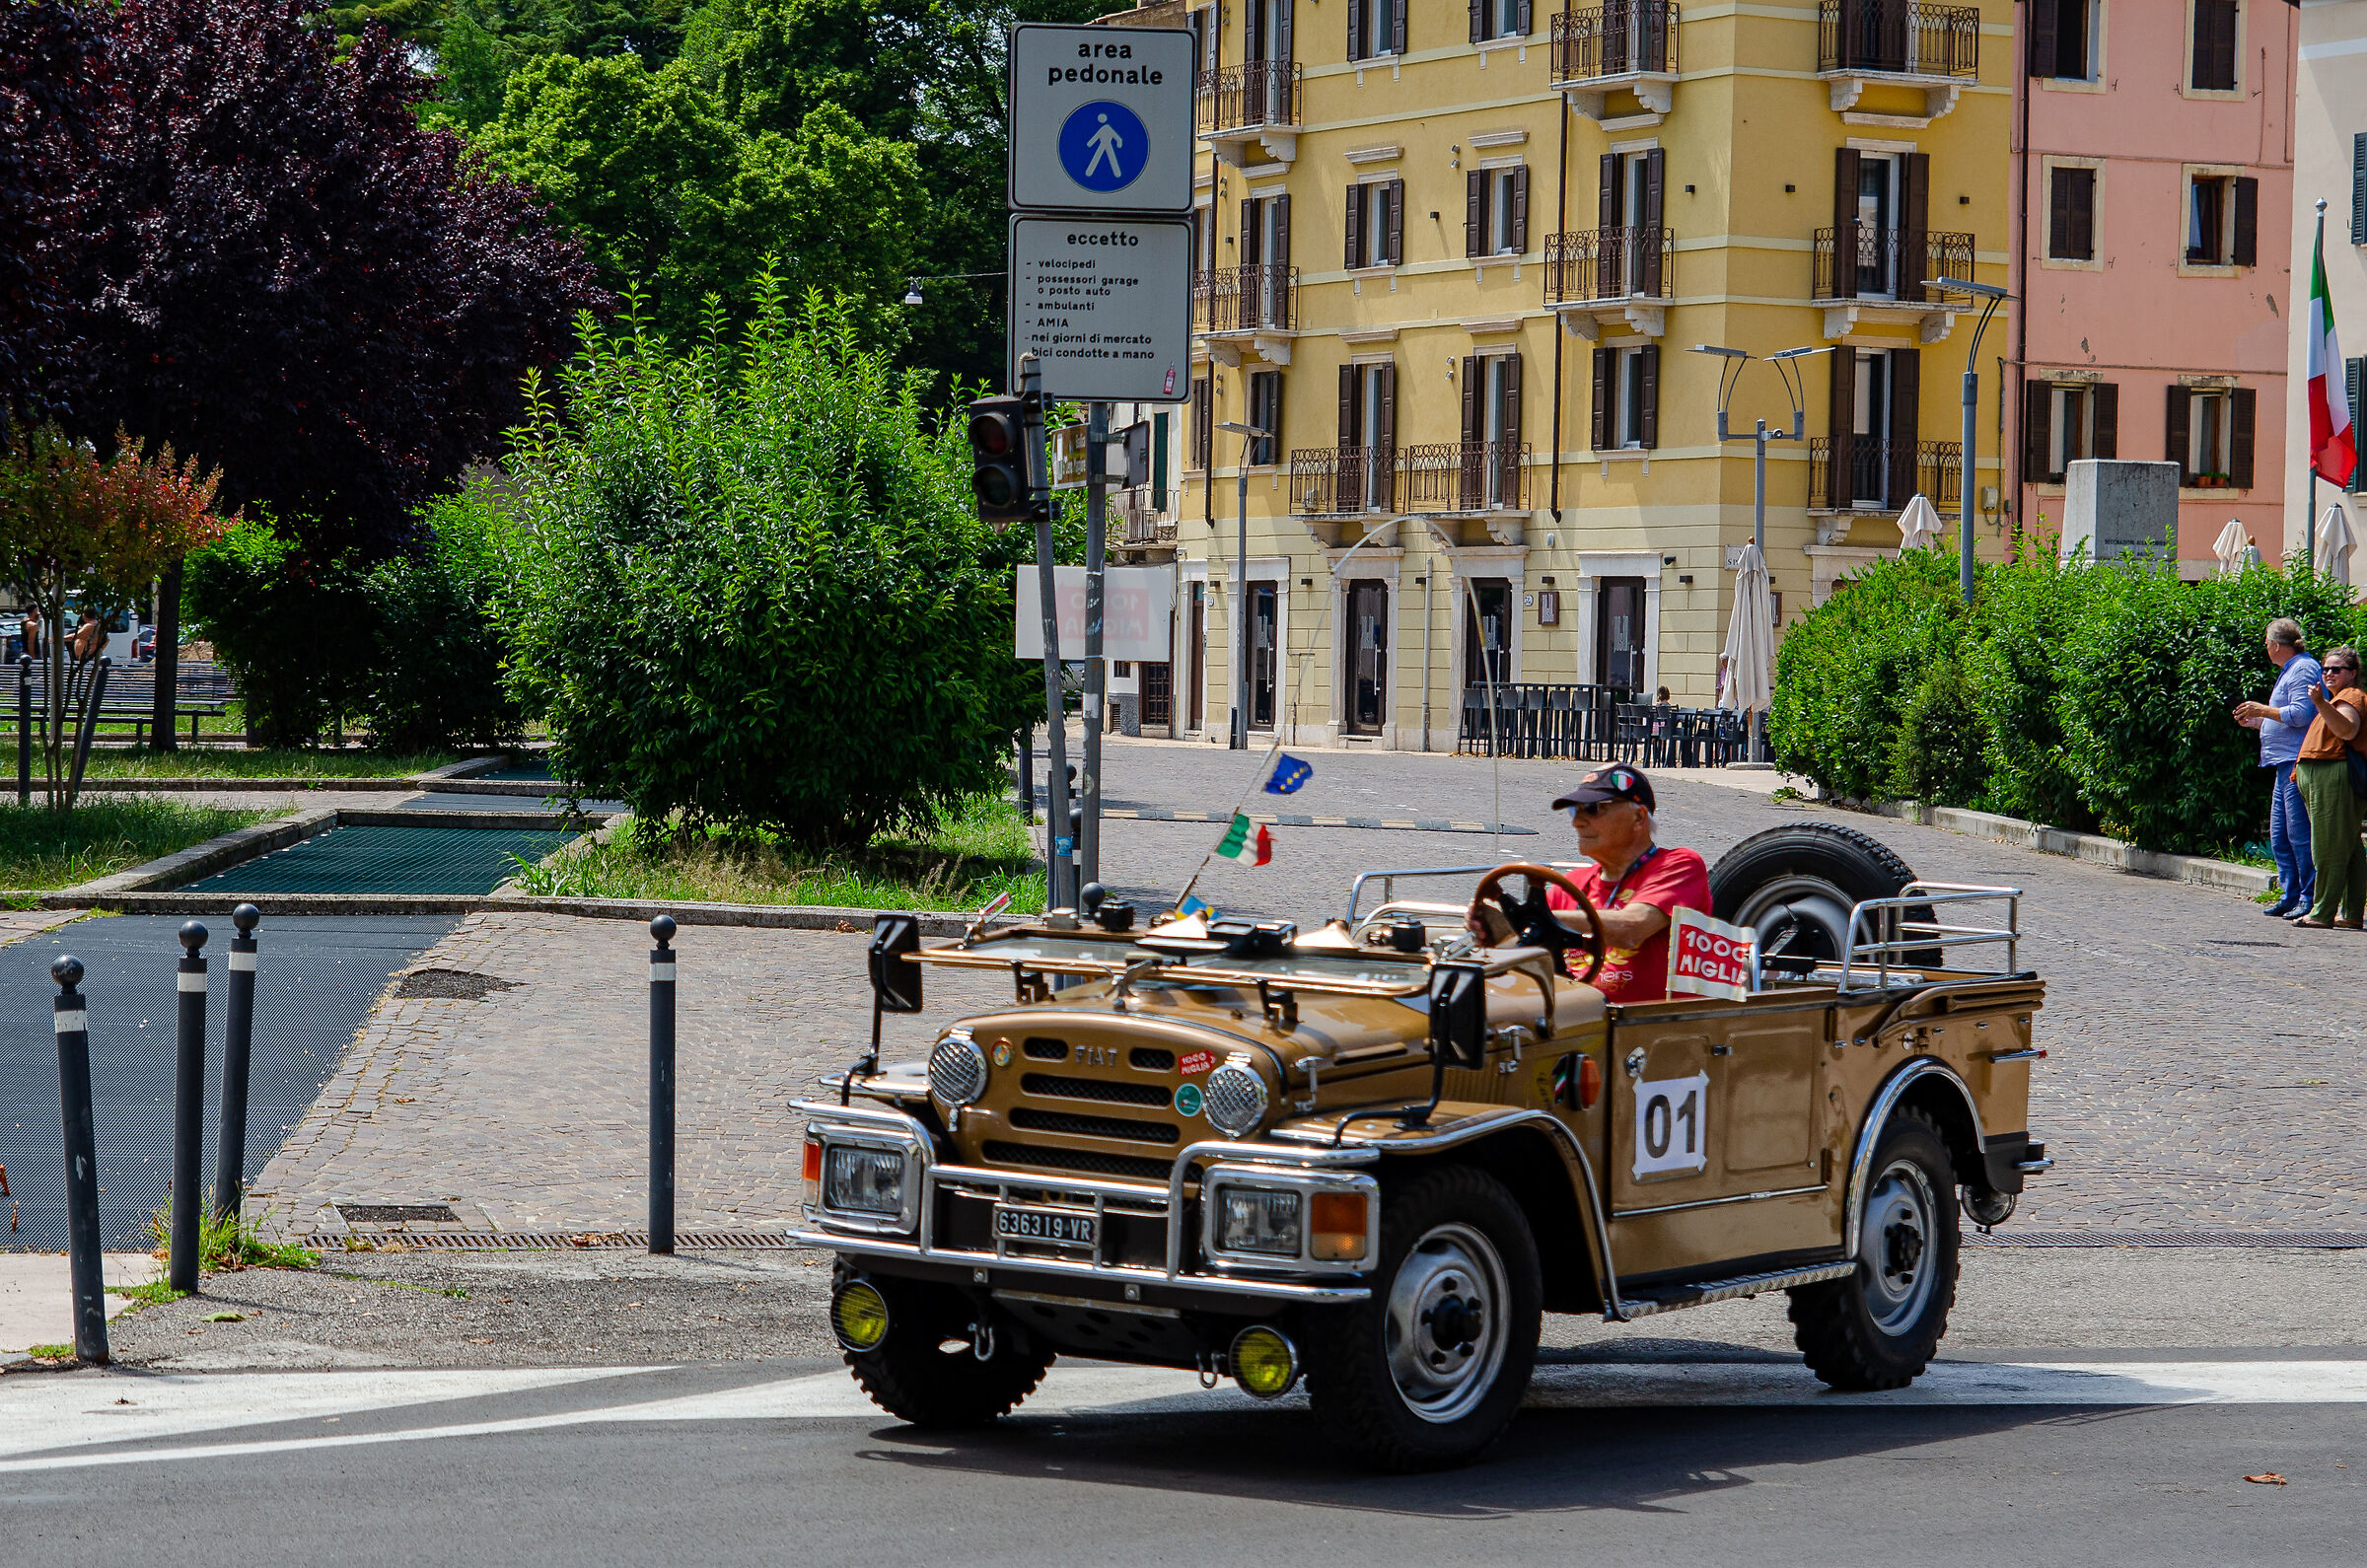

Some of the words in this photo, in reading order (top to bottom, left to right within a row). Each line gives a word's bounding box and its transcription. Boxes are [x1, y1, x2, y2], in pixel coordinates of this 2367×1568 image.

[1078, 42, 1132, 59] area
[1047, 64, 1163, 86] pedonale
[1067, 231, 1139, 247] eccetto
[1039, 259, 1096, 270] velocipedi
[1038, 275, 1097, 285] possessori
[1101, 276, 1139, 287] garage
[1049, 286, 1081, 296] posto
[1085, 287, 1112, 296] auto
[1038, 301, 1095, 311] ambulanti
[1037, 318, 1069, 327] AMIA
[1032, 332, 1049, 342] nei
[1052, 333, 1086, 344] giorni
[1089, 333, 1101, 343] di
[1104, 334, 1152, 344] mercato
[1031, 347, 1053, 357] bici
[1055, 348, 1110, 359] condotte
[1122, 350, 1155, 359] mano
[1075, 1045, 1118, 1066] FIAT
[1182, 1061, 1210, 1074] MIGLIA
[1645, 1090, 1697, 1159] 01
[999, 1212, 1063, 1238] 636319
[1070, 1218, 1091, 1241] VR
